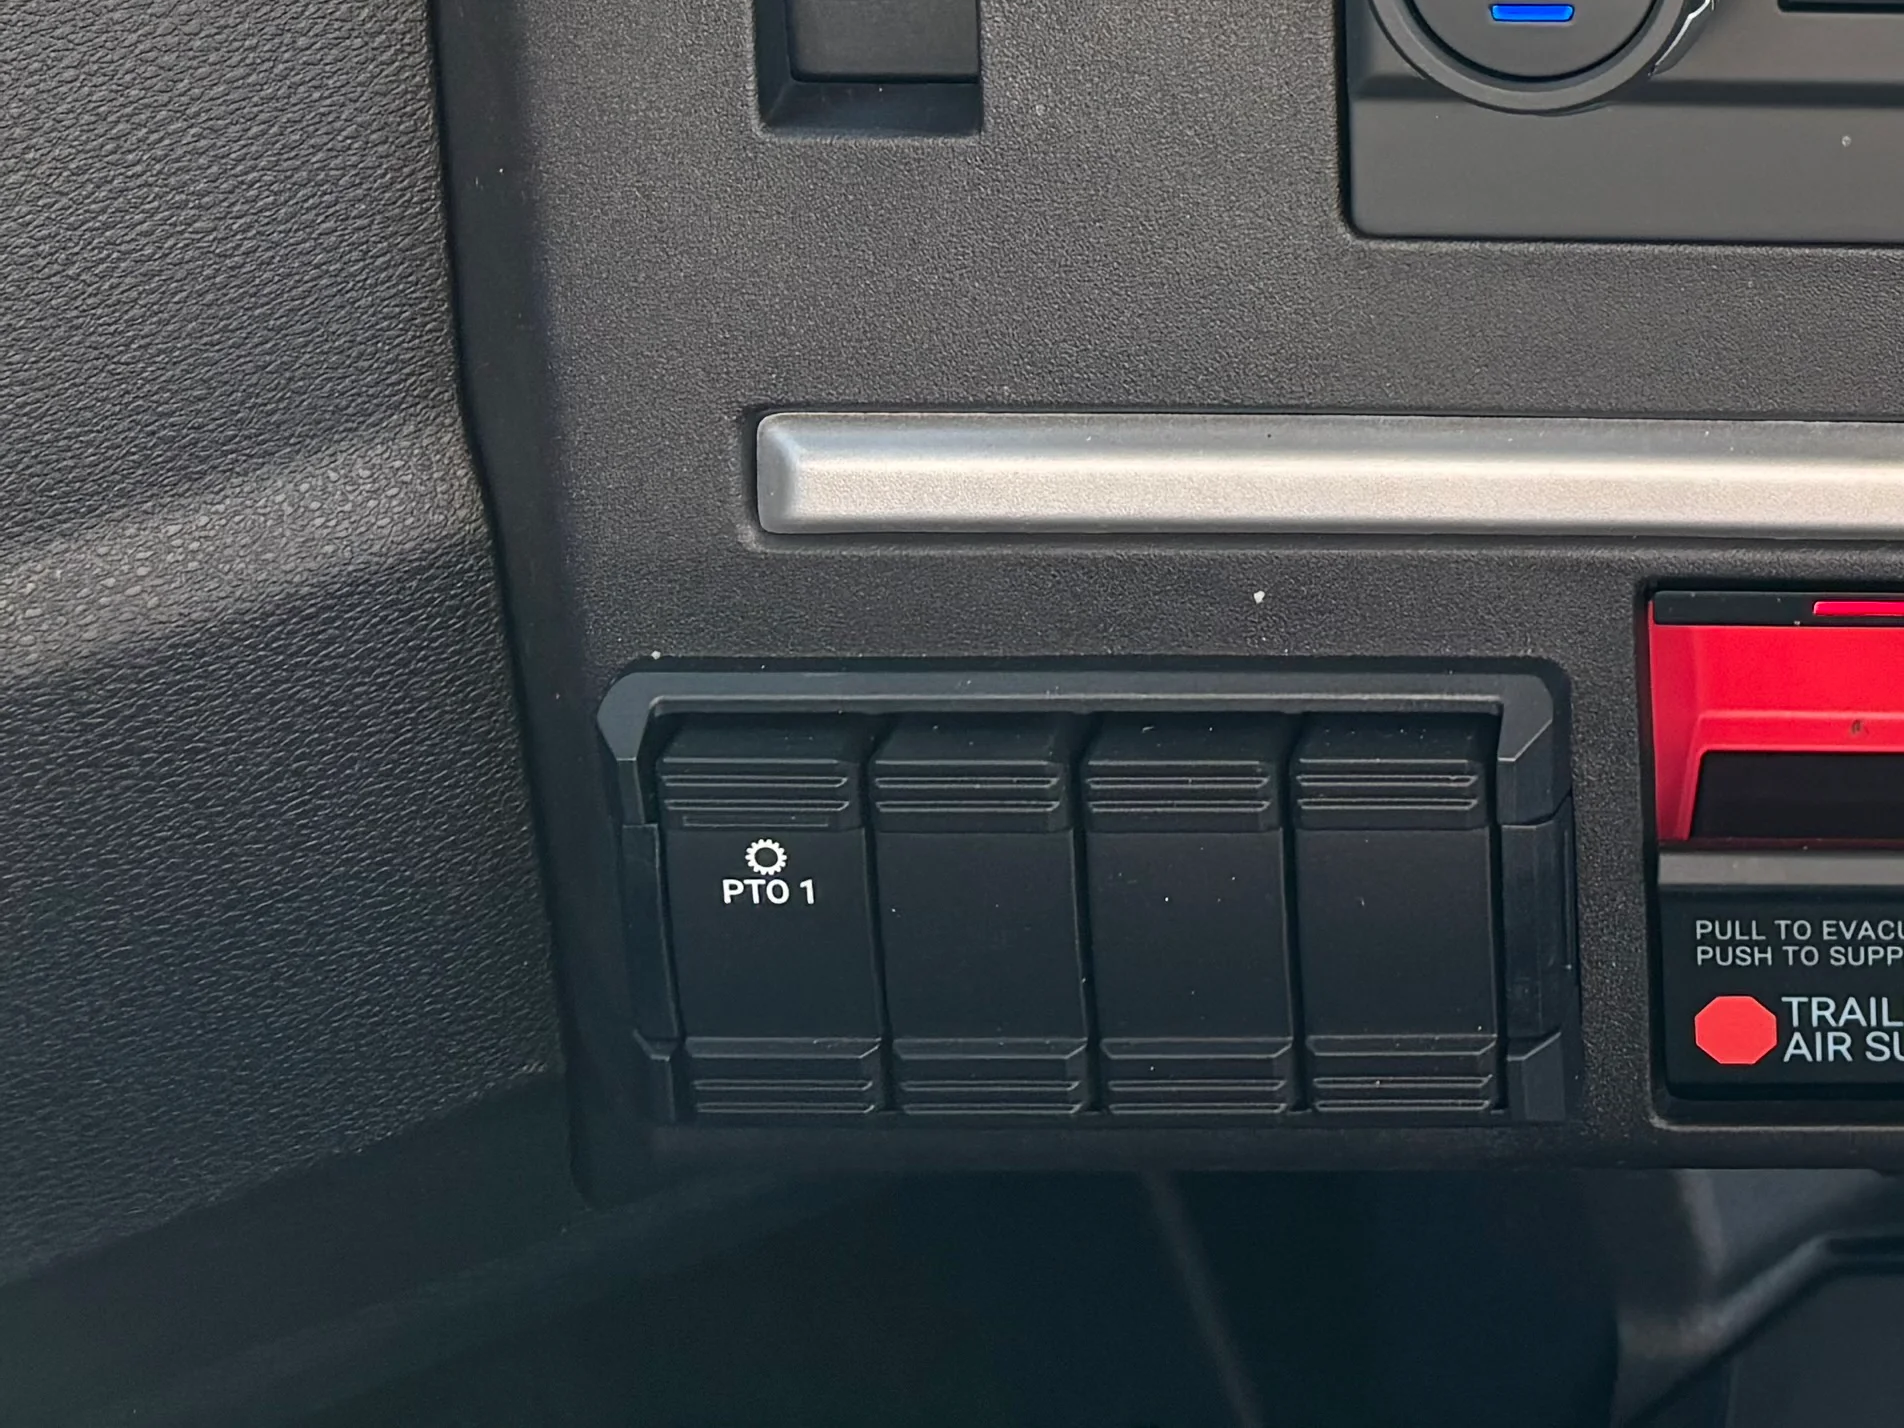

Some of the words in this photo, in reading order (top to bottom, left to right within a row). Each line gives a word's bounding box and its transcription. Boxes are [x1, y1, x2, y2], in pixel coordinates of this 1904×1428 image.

[722, 878, 790, 905] PTO
[799, 879, 815, 905] 1
[1695, 918, 1766, 941] PULL
[1774, 919, 1812, 941] TO
[1696, 945, 1773, 967] PUSH
[1782, 945, 1819, 966] TO
[1783, 1030, 1853, 1062] AIR
